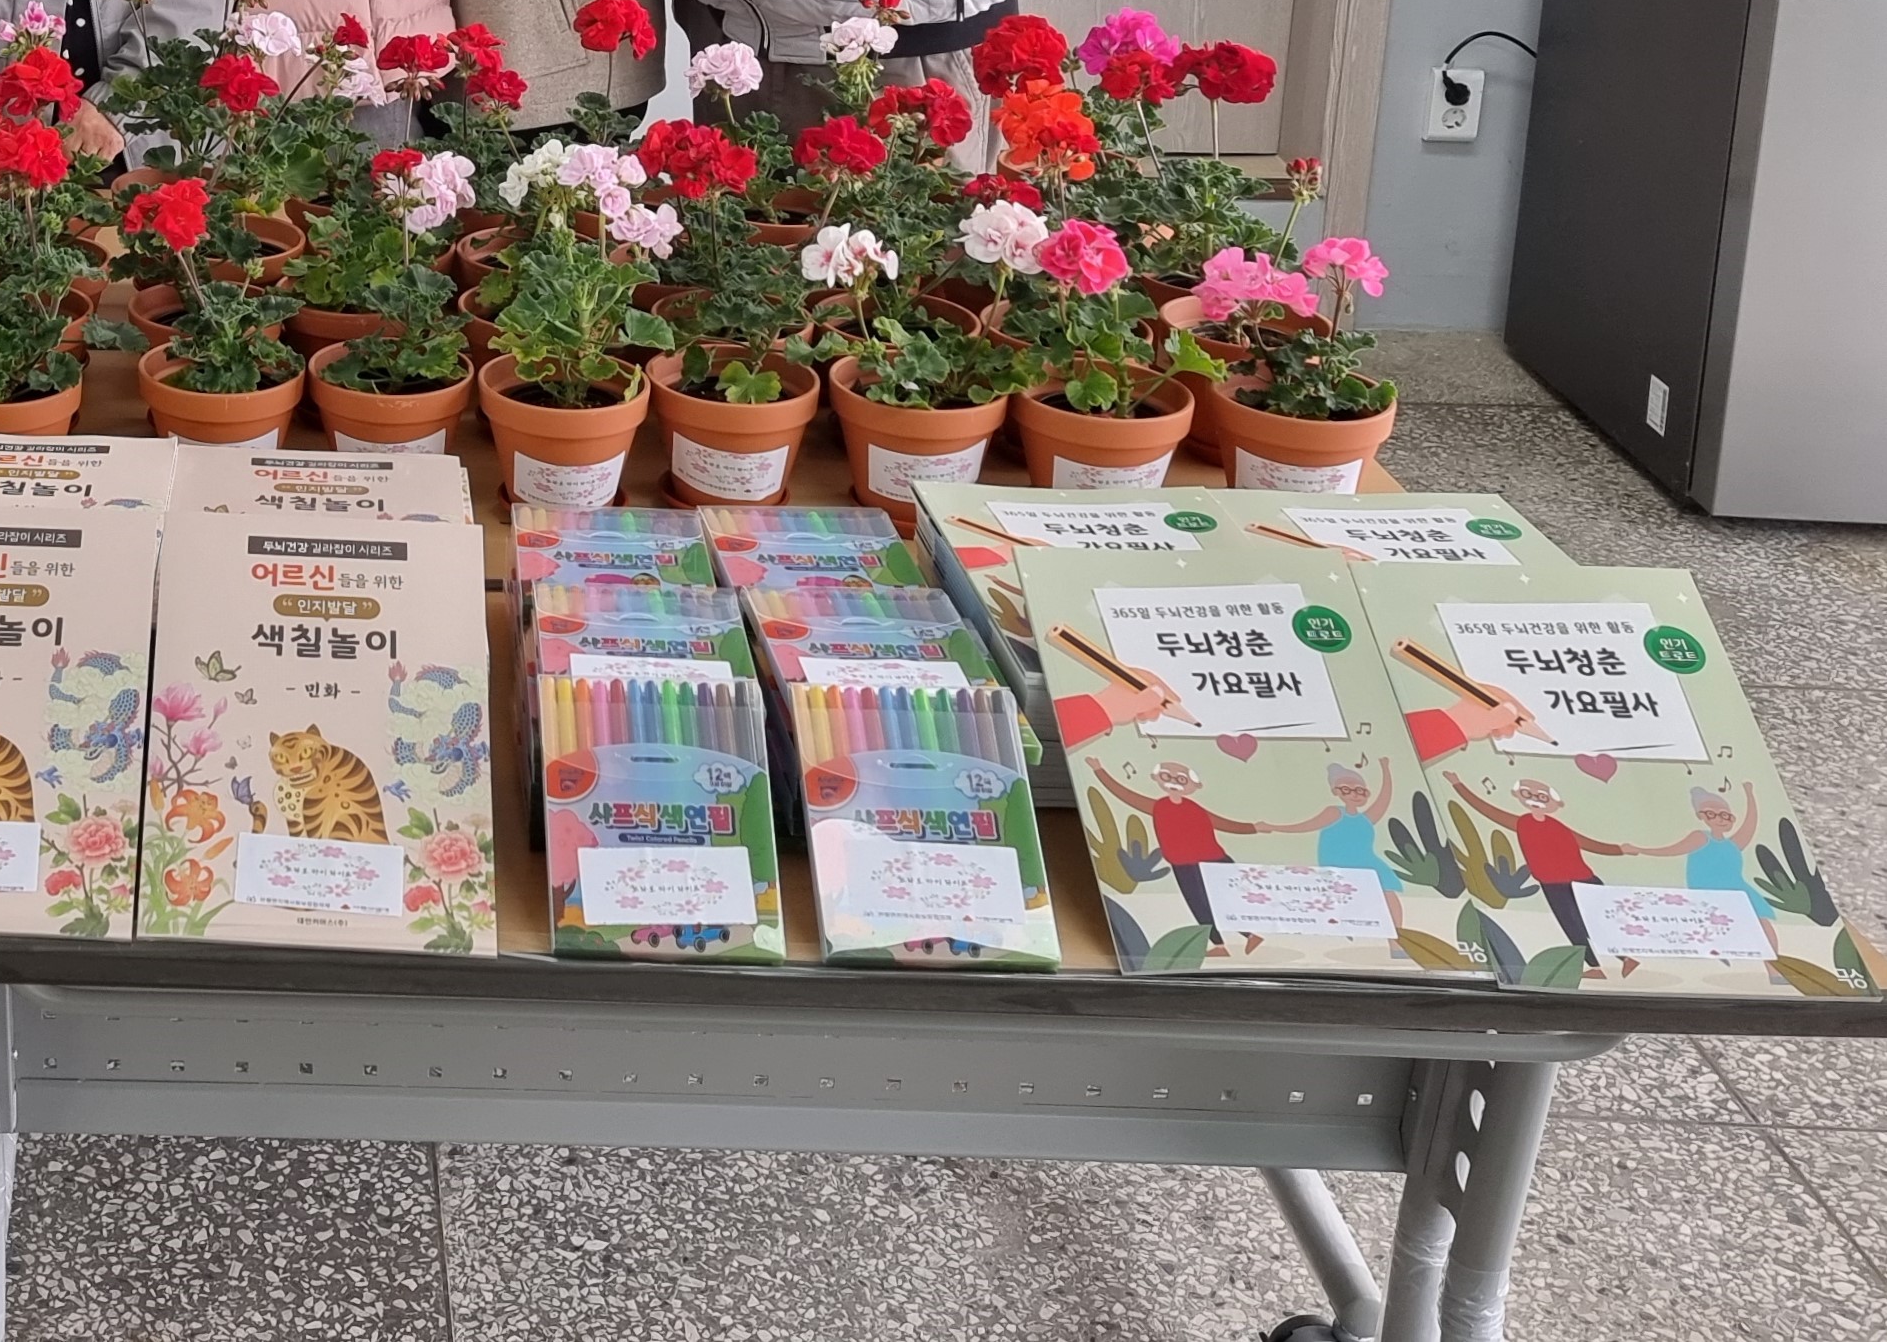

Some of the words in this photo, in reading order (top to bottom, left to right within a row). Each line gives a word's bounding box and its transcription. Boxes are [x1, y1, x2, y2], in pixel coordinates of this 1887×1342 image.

[254, 495, 385, 512] 색칠놀이
[33, 531, 67, 543] 시리즈
[1043, 522, 1149, 536] 두뇌청춘
[1344, 529, 1455, 543] 두뇌청춘
[263, 540, 309, 553] 두뇌건강
[311, 542, 356, 556] 길라잡이
[358, 544, 393, 556] 시리즈
[1383, 547, 1487, 561] 가요필사
[44, 561, 76, 577] 위한
[251, 563, 369, 591] 어르신들을
[372, 574, 404, 590] 위한
[297, 599, 357, 615] 인지발달
[1110, 607, 1151, 619] 365일
[1155, 605, 1221, 619] 두뇌건강을
[1225, 603, 1252, 617] 위한
[1258, 602, 1285, 616] 활동
[1307, 617, 1335, 630] 인기
[1455, 622, 1498, 636] 365일
[1501, 621, 1570, 635] 두뇌건강을
[1574, 622, 1602, 635] 위한
[1607, 621, 1635, 635] 활동
[251, 624, 397, 660] 색칠놀이
[1156, 629, 1274, 658] 두뇌청춘
[1659, 637, 1689, 651] 인기
[1504, 647, 1627, 676] 두뇌청춘
[304, 682, 341, 699] 민화
[1191, 671, 1302, 698] 가요필사
[1543, 689, 1660, 719] 가요필사
[588, 801, 734, 833] 샤프식색연필
